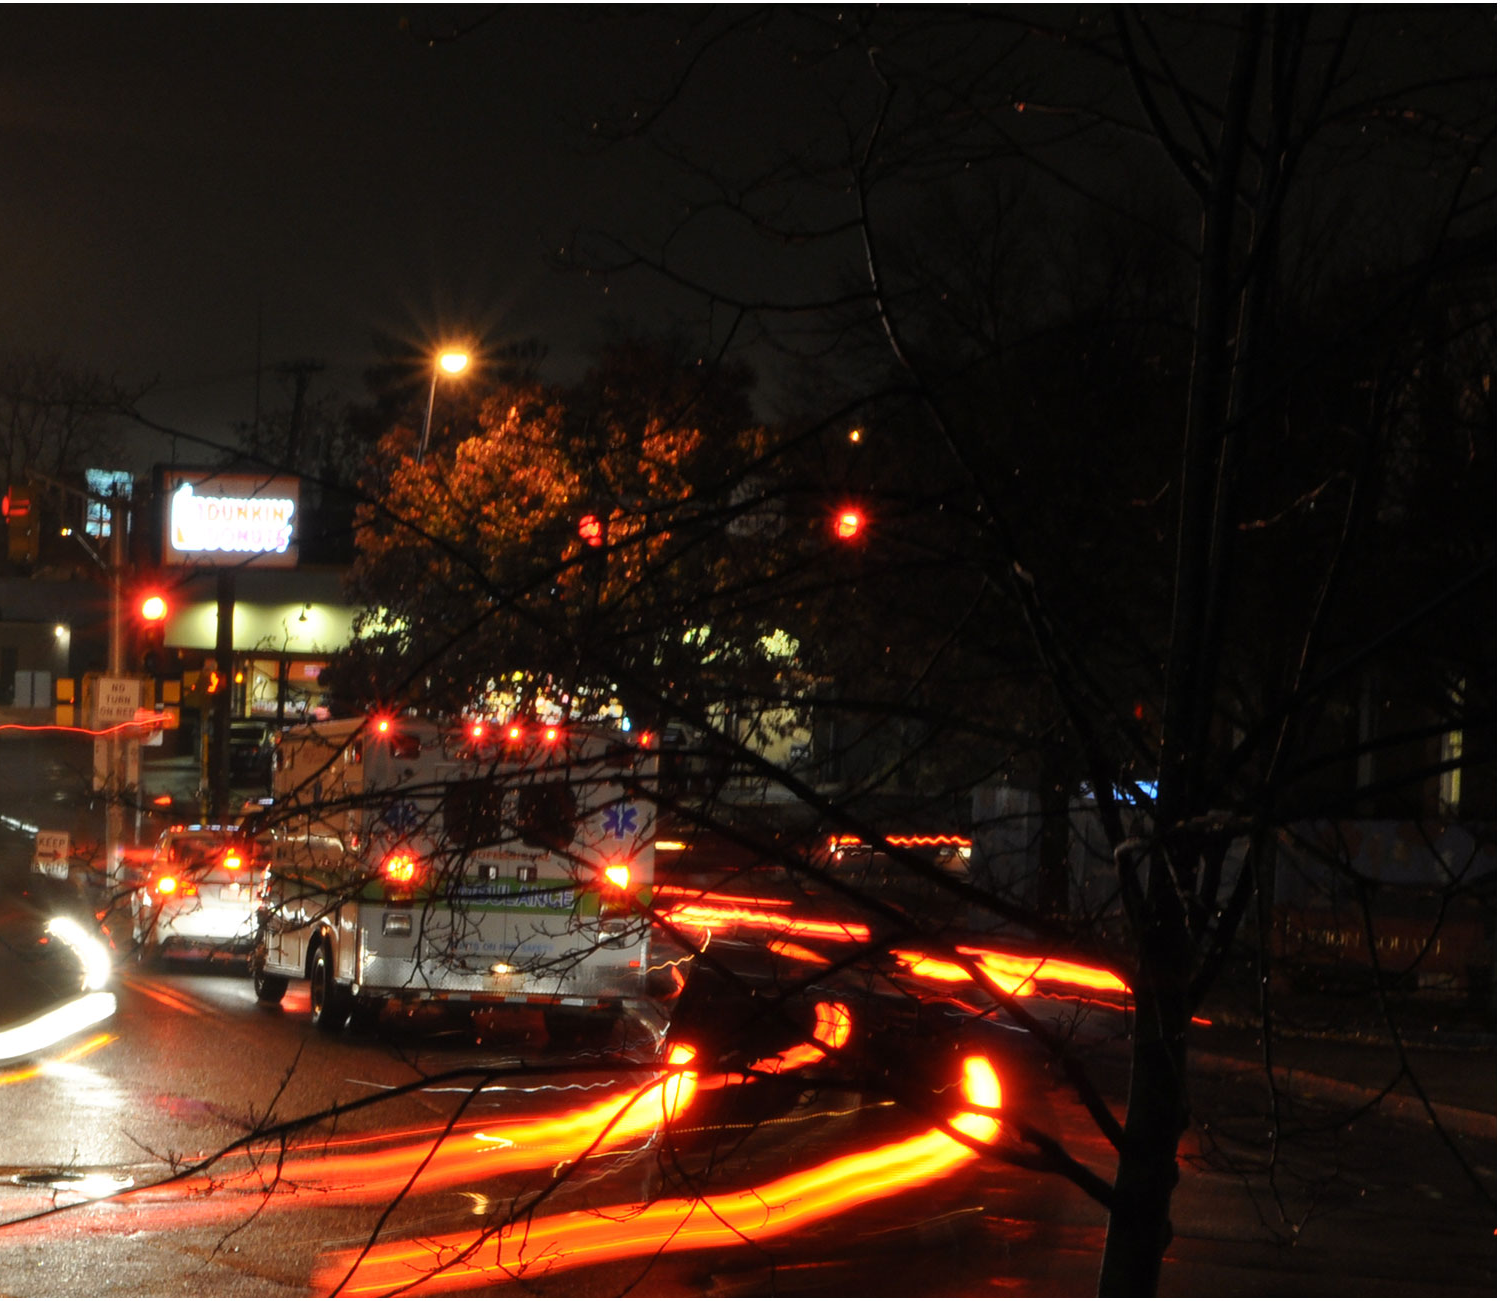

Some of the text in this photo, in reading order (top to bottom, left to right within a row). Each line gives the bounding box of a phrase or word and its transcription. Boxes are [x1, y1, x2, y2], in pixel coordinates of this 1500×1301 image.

[208, 528, 286, 548] DONUTS
[111, 683, 126, 692] NO
[106, 695, 131, 704] TURN
[99, 706, 135, 717] ON RED
[39, 837, 66, 848] KEEP
